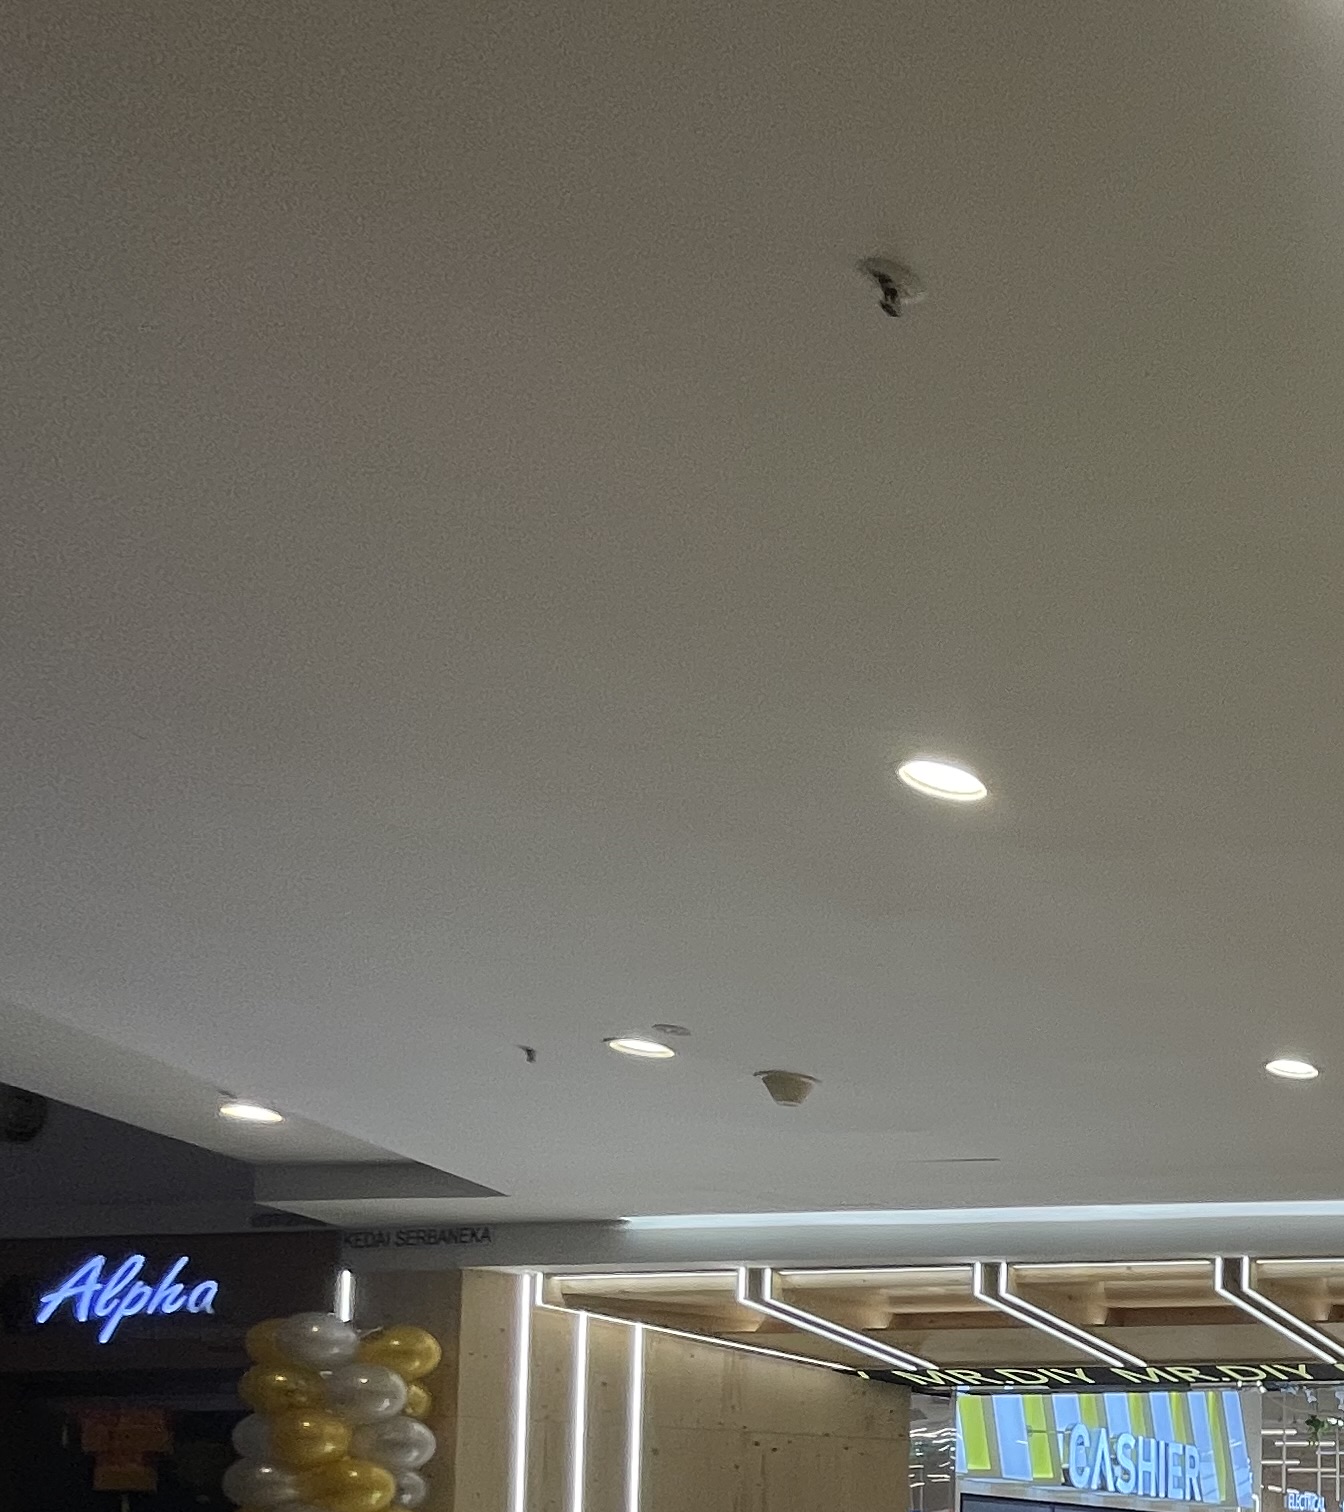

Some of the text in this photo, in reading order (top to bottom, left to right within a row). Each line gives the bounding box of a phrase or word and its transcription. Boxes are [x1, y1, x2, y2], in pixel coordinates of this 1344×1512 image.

[395, 1226, 492, 1248] SERBANEKA
[35, 1253, 220, 1344] Alpha
[891, 1366, 1096, 1386] MR.DIY
[1110, 1363, 1314, 1383] MR.DIY
[1067, 1422, 1206, 1503] CASHIER
